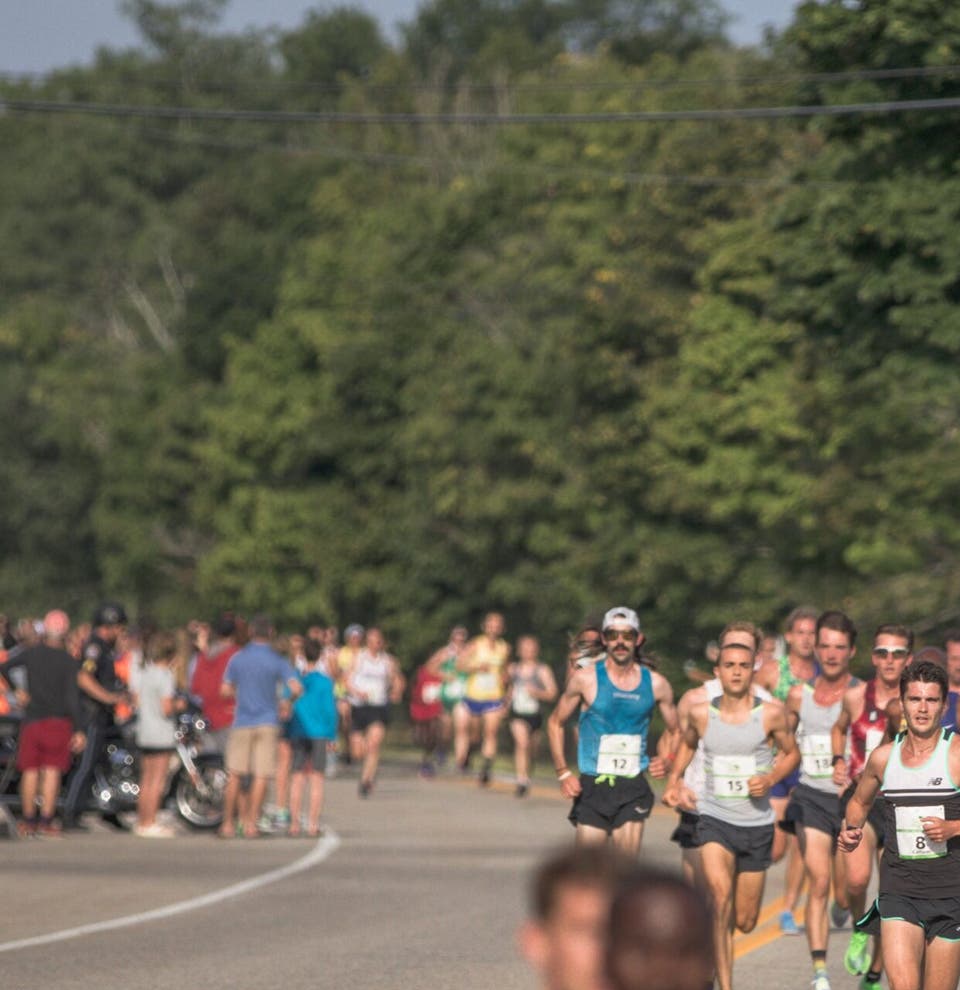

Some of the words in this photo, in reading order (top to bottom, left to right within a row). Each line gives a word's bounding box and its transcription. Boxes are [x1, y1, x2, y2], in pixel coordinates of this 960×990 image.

[612, 758, 627, 769] 12
[728, 780, 744, 792] 15
[915, 836, 926, 850] 8
